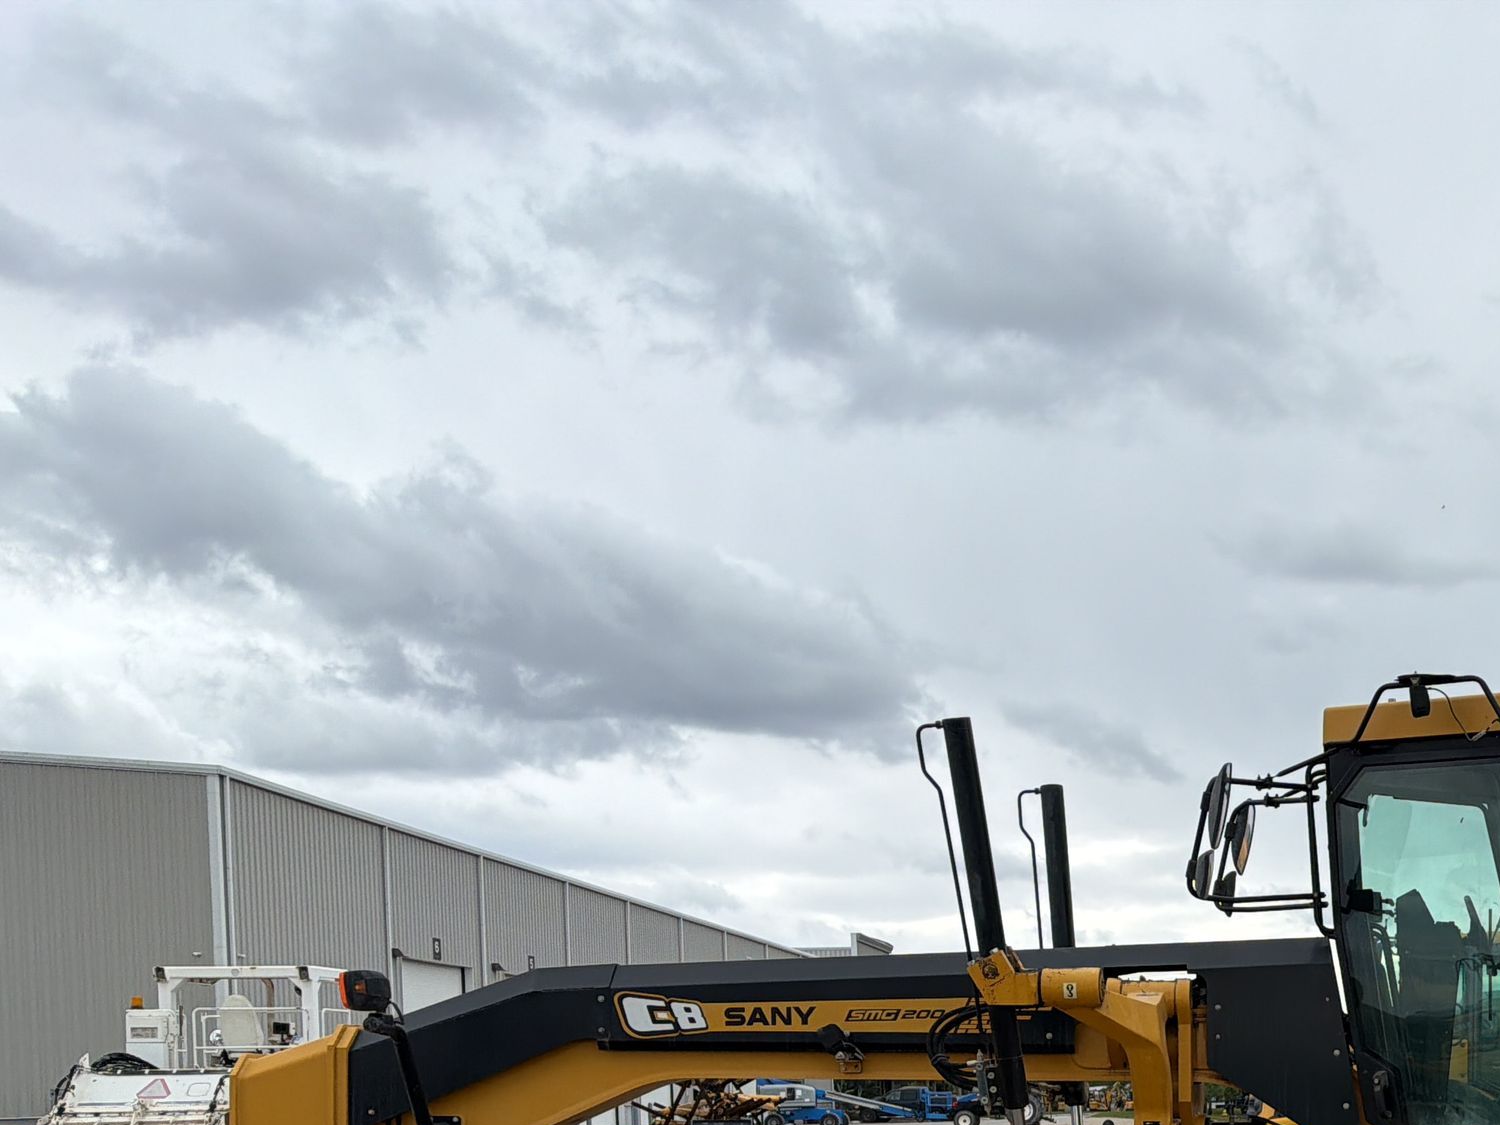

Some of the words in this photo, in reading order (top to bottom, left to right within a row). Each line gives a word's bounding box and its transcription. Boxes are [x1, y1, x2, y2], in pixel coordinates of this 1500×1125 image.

[433, 941, 440, 954] 6
[724, 1006, 817, 1027] SANY
[845, 1009, 902, 1022] SMG
